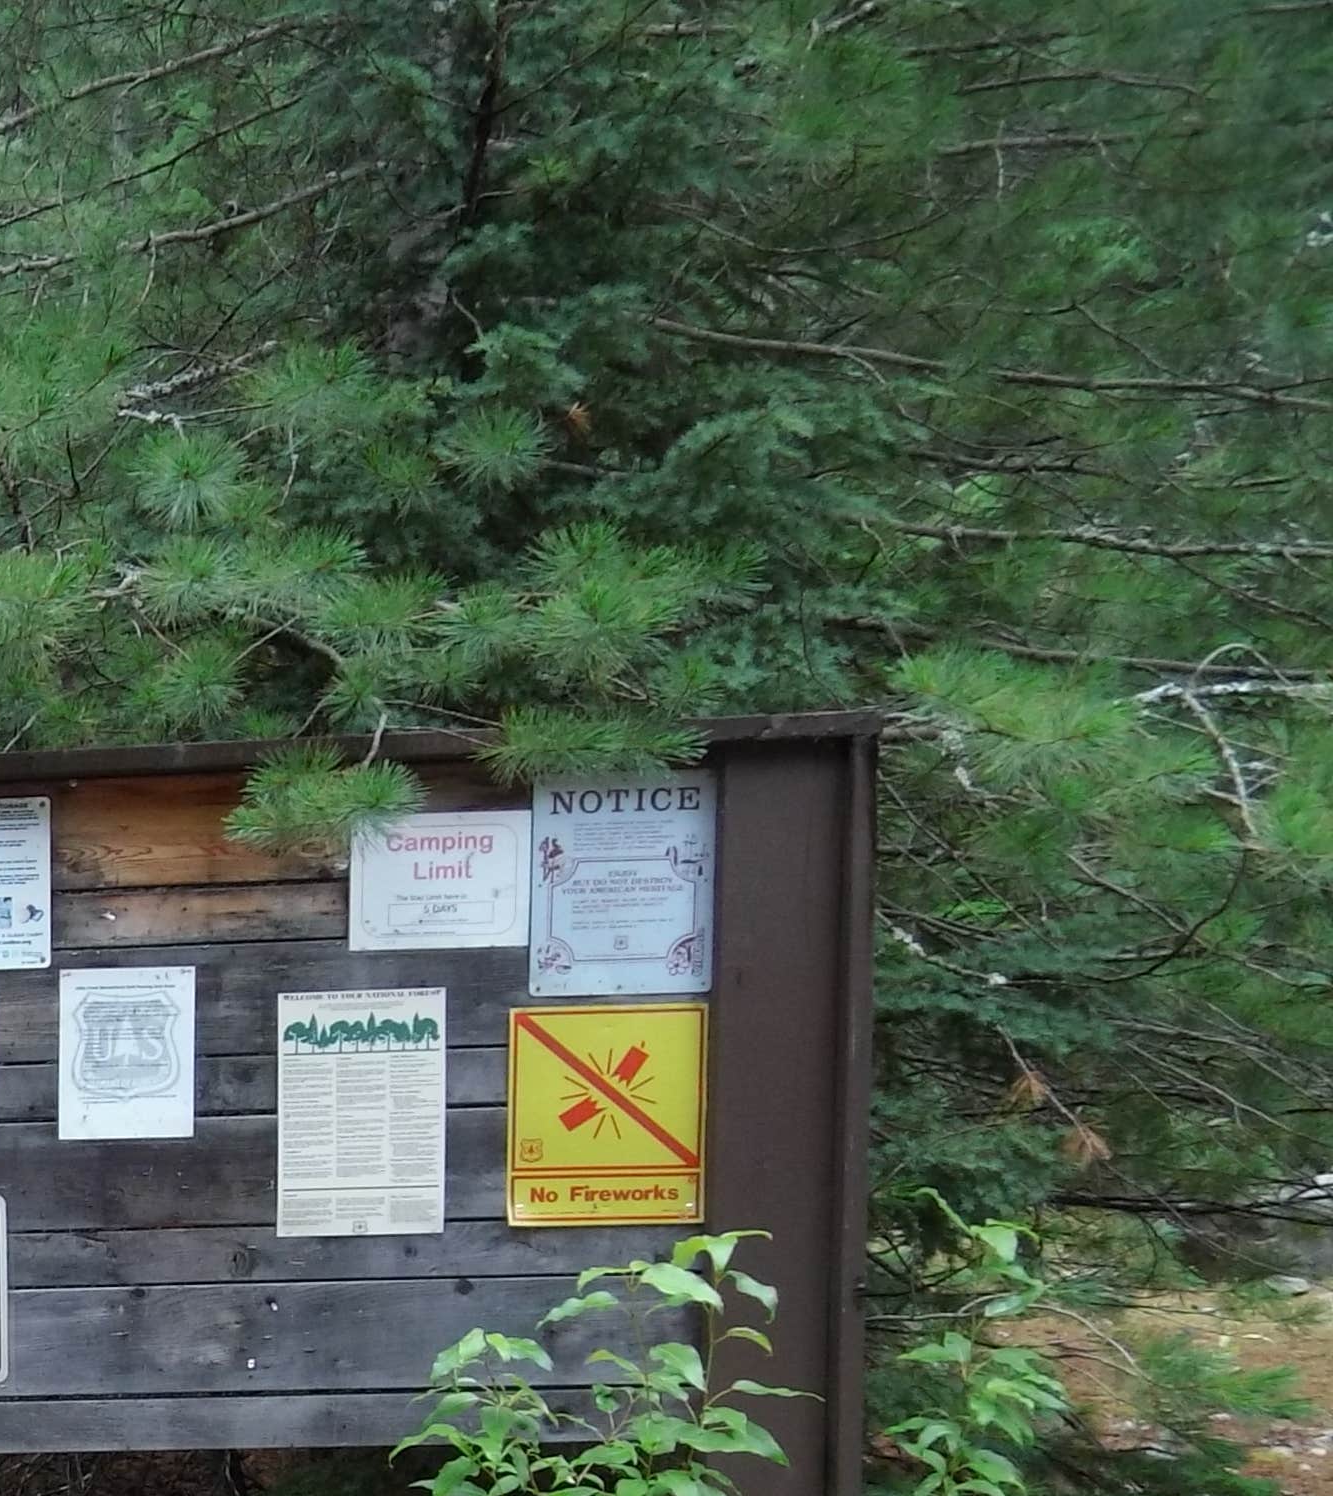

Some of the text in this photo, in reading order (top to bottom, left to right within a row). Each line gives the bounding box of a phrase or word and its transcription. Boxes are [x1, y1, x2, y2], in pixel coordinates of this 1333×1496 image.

[550, 786, 701, 815] NOTICE
[386, 831, 494, 854] Camping
[413, 859, 473, 880] Limit
[366, 991, 405, 999] NATIONAL
[408, 989, 442, 997] FOREST
[530, 1184, 679, 1203] No Fireworks
